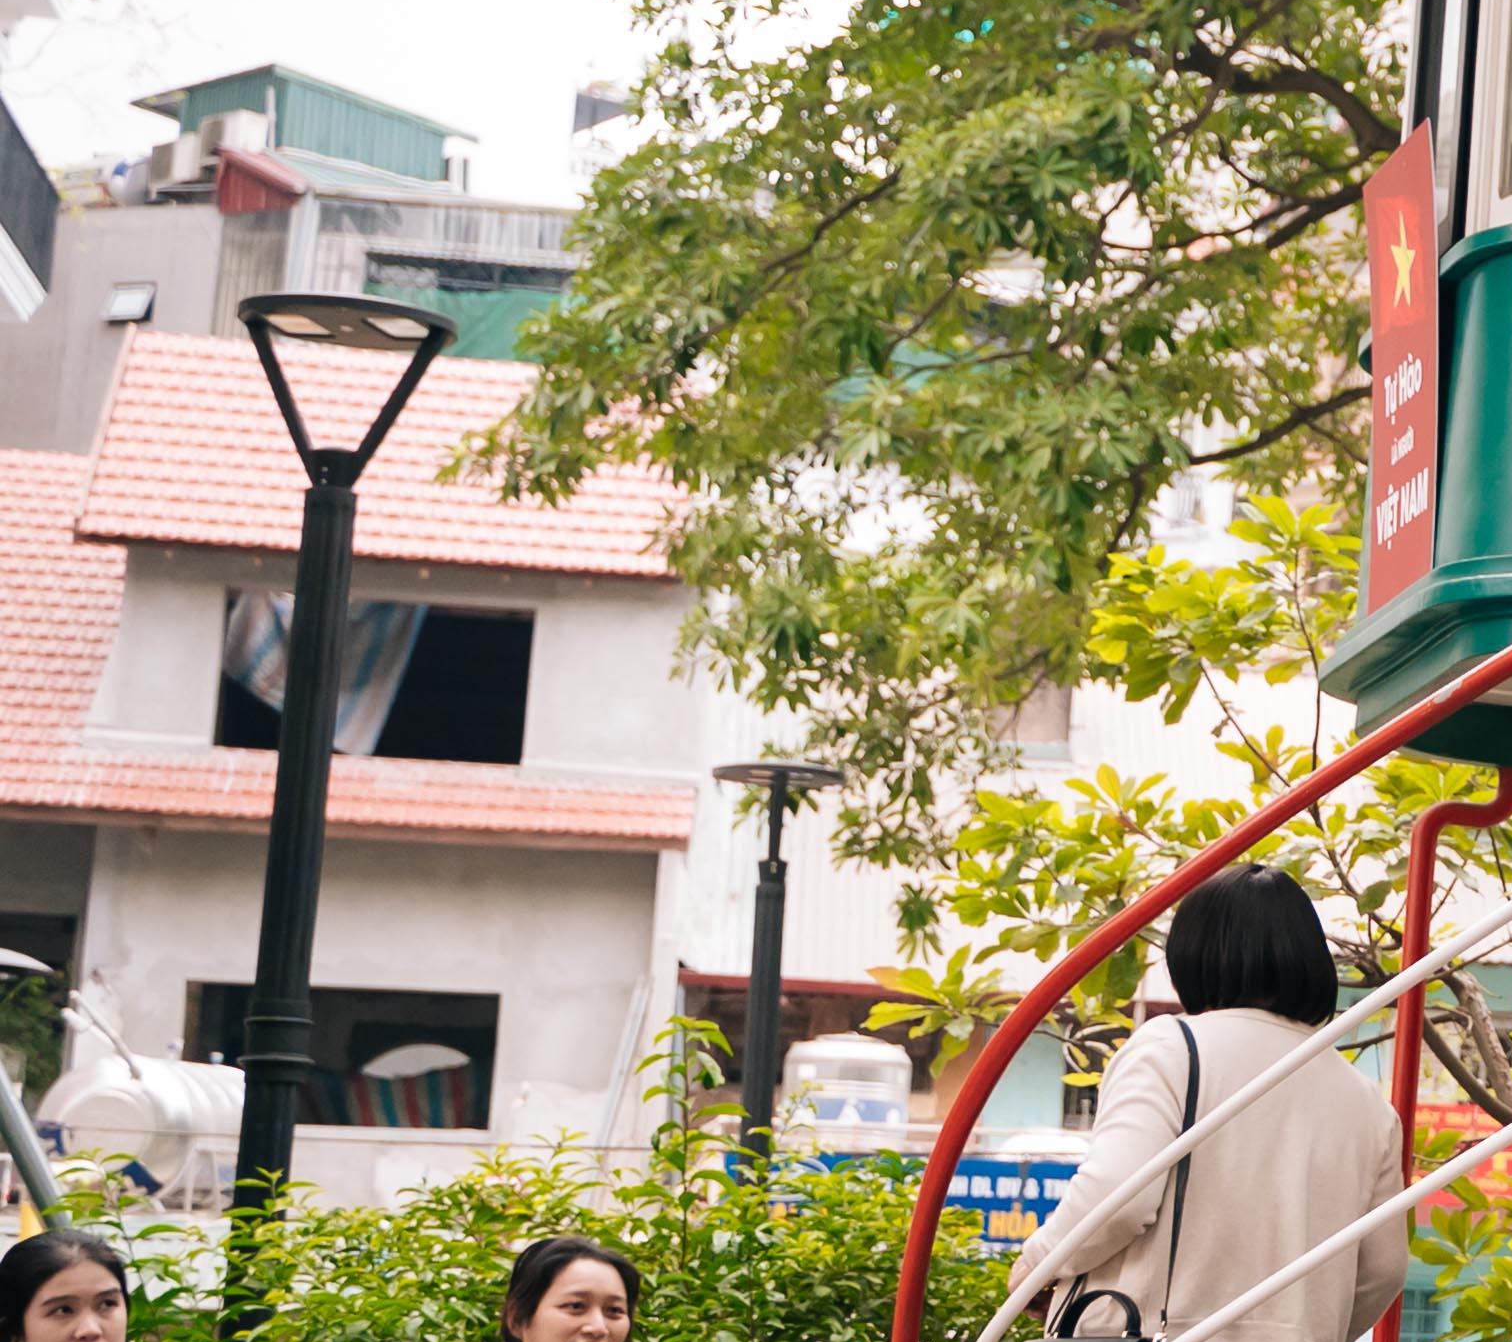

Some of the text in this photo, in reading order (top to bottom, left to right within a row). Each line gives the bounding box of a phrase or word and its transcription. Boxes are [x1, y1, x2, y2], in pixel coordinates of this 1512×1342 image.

[1398, 352, 1423, 406] Hào
[1376, 467, 1430, 550] VIỆT NAM
